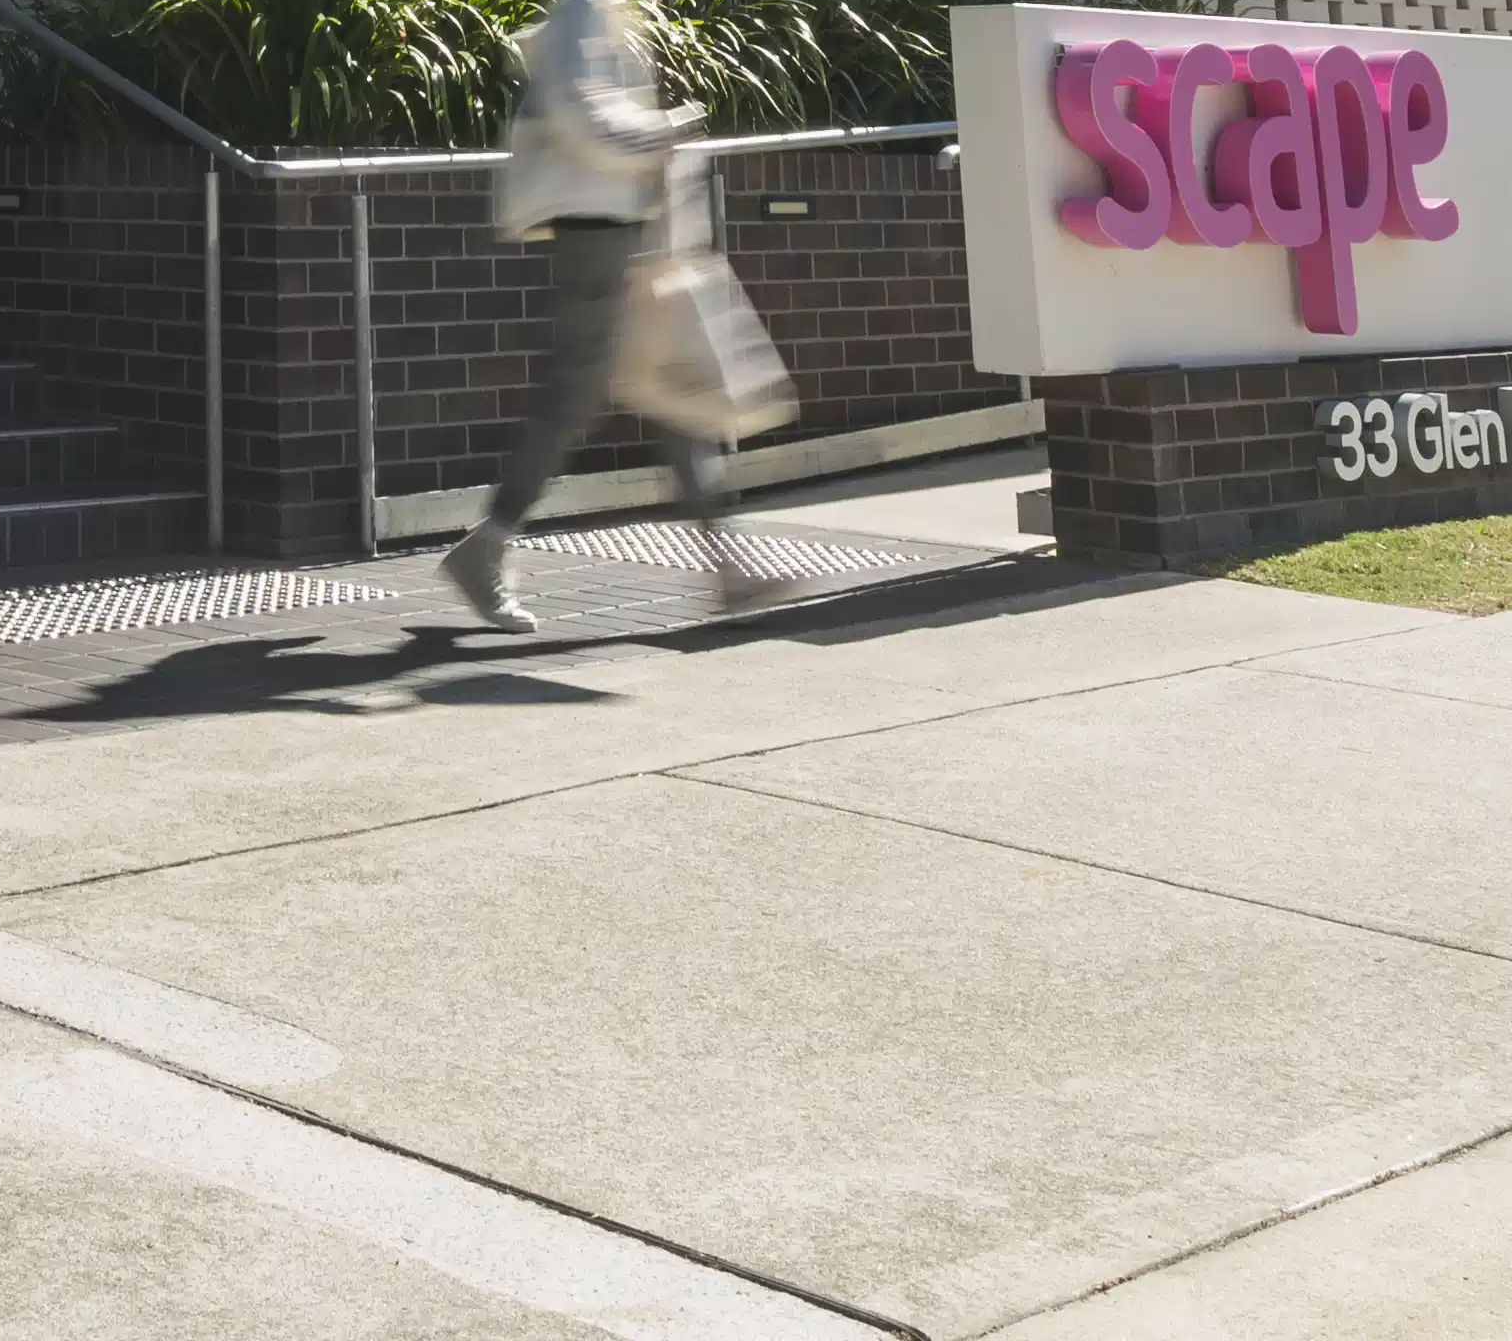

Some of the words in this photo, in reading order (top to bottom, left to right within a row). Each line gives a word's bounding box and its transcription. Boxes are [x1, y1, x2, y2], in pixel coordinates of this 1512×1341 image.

[1057, 38, 1460, 336] scape
[1325, 390, 1399, 482] 33
[1401, 392, 1508, 474] Glen
